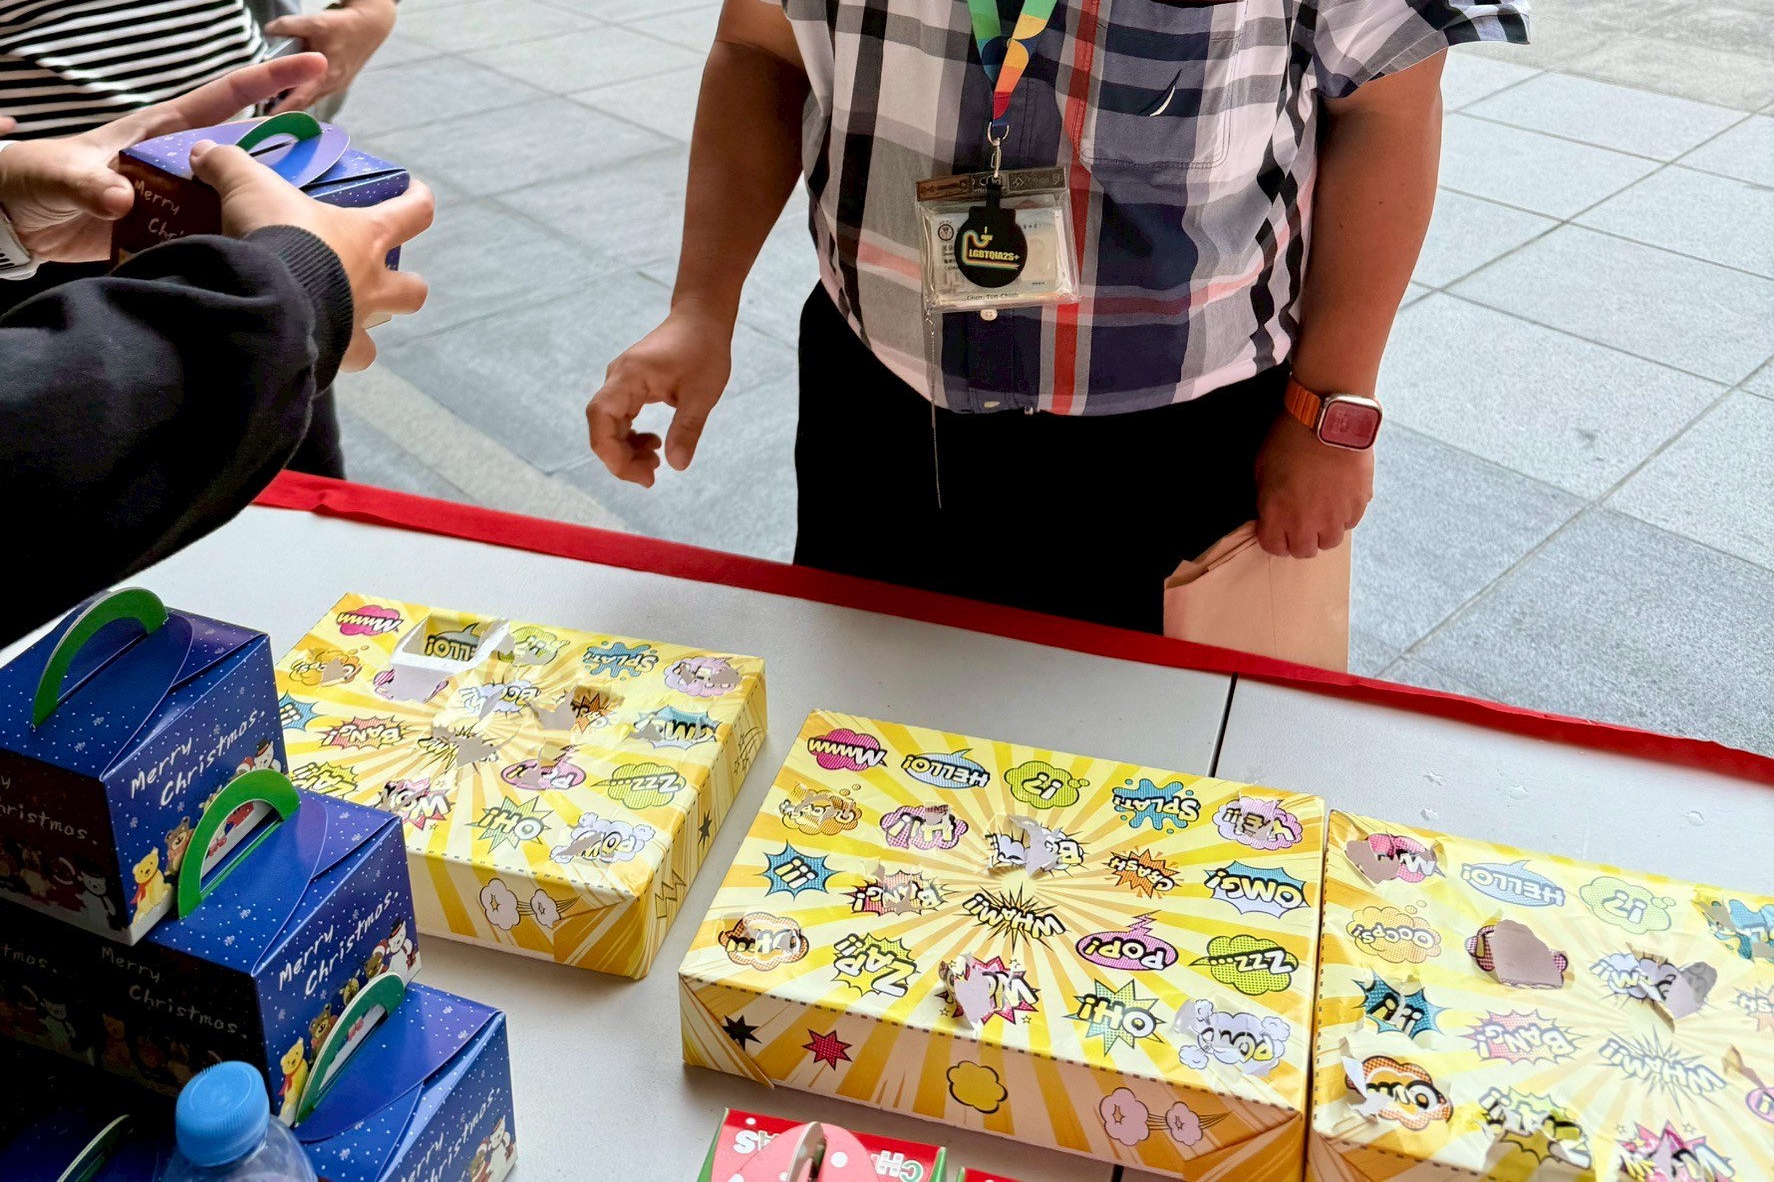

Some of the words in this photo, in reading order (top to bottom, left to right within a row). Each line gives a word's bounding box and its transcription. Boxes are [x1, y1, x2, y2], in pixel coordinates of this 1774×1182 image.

[134, 179, 180, 215] Merry
[321, 723, 402, 747] BANG!
[131, 736, 194, 799] Merry
[161, 710, 267, 806] Christmas.
[901, 755, 990, 788] HELLO!
[1022, 772, 1063, 801] !?
[478, 807, 544, 840] OH!
[774, 857, 818, 889] !!!
[1109, 857, 1175, 892] CRASH
[1204, 868, 1304, 909] OMG!
[1461, 863, 1566, 907] HELLO!
[962, 893, 1066, 939] WHAM!!
[1601, 889, 1648, 924] !?
[279, 924, 336, 992] Merry
[303, 890, 400, 997] Christmas.
[1083, 936, 1167, 971] POP!
[101, 945, 161, 983] Merry
[834, 933, 917, 998] ZAP!!
[1077, 994, 1156, 1038] OH!
[1475, 1022, 1576, 1060] BANG!
[1599, 1038, 1728, 1096] WHAM!!
